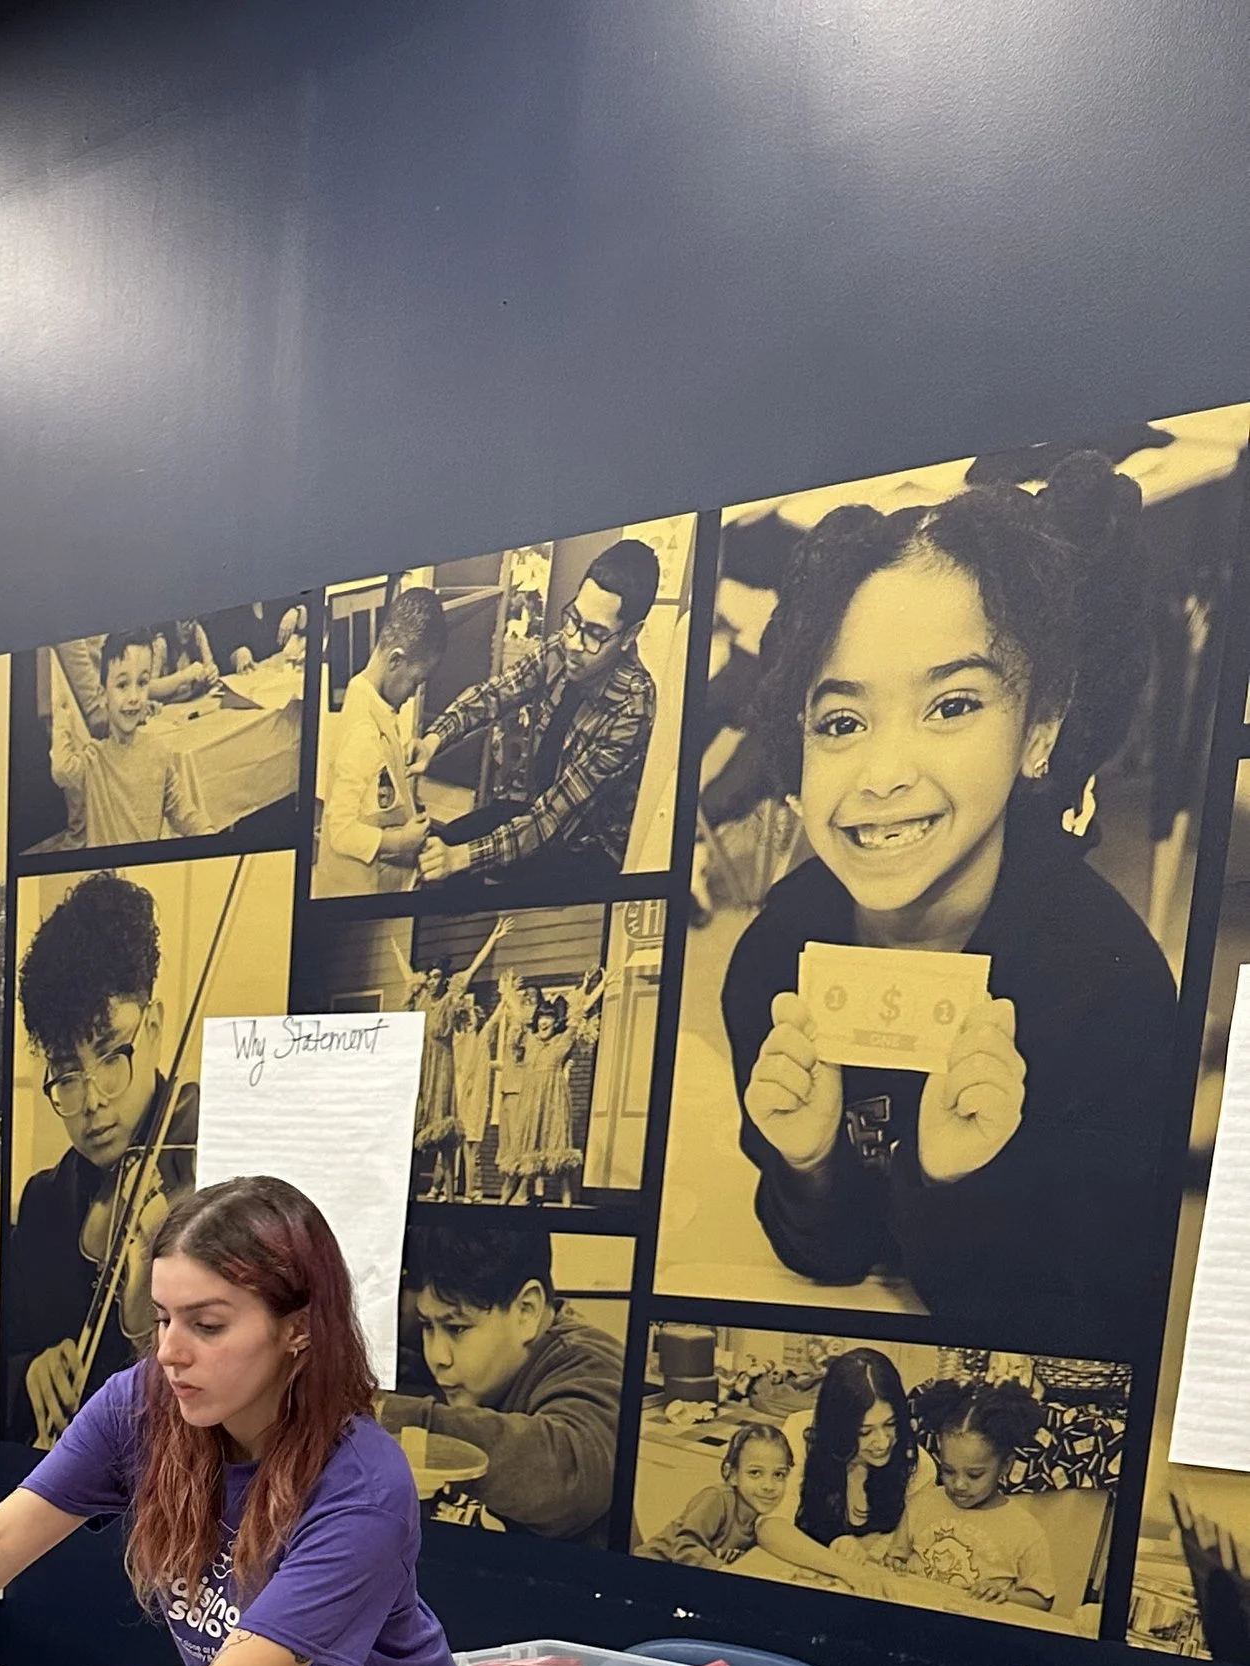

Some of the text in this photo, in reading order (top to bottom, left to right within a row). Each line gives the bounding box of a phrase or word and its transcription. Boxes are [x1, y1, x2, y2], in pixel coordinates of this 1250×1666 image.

[233, 1016, 389, 1087] Why Statement
[167, 1598, 222, 1638] solo
[168, 1575, 240, 1632] aising
